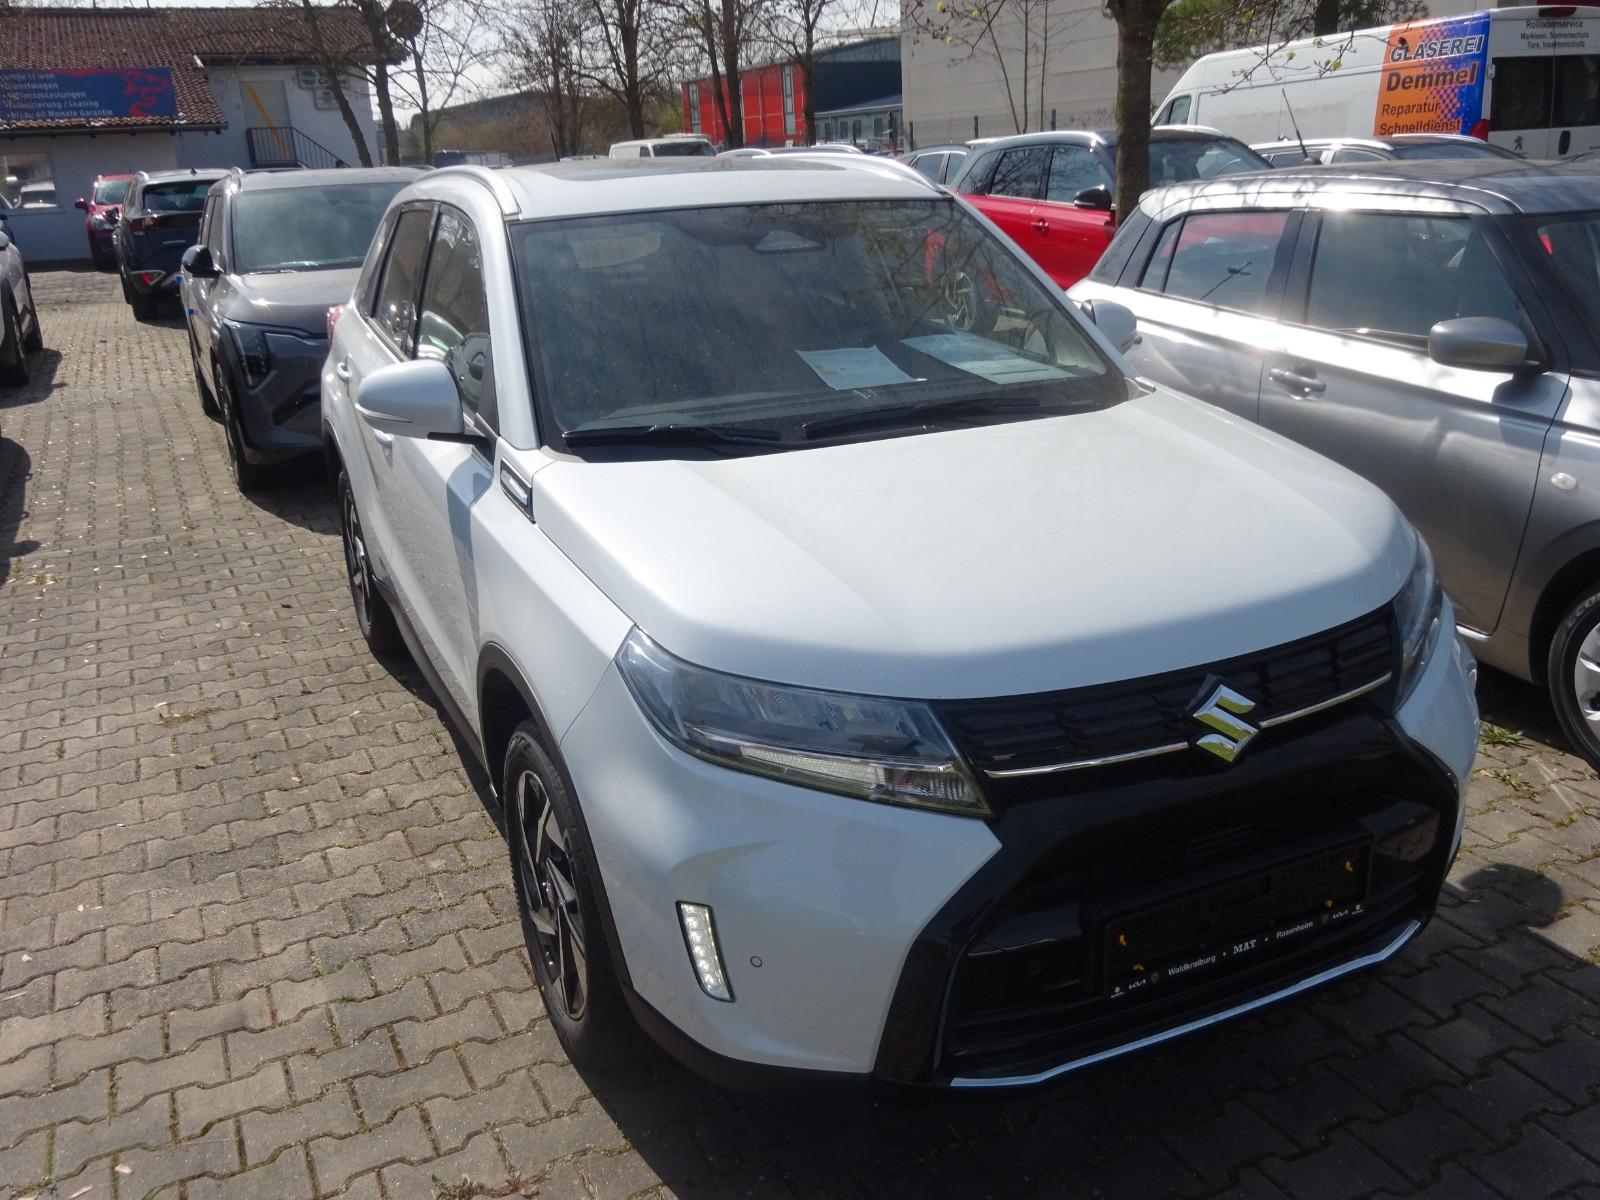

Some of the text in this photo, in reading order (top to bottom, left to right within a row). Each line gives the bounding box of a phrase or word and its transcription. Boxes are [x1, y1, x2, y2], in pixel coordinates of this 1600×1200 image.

[1389, 35, 1485, 62] GLASEREI
[1386, 61, 1479, 91] Demmel
[1382, 100, 1441, 118] Reparatur
[1379, 117, 1463, 136] Schnelldienst
[1167, 955, 1217, 976] Waldkraiburg
[1232, 939, 1257, 955] MAT
[1276, 921, 1314, 939] Rosenheim
